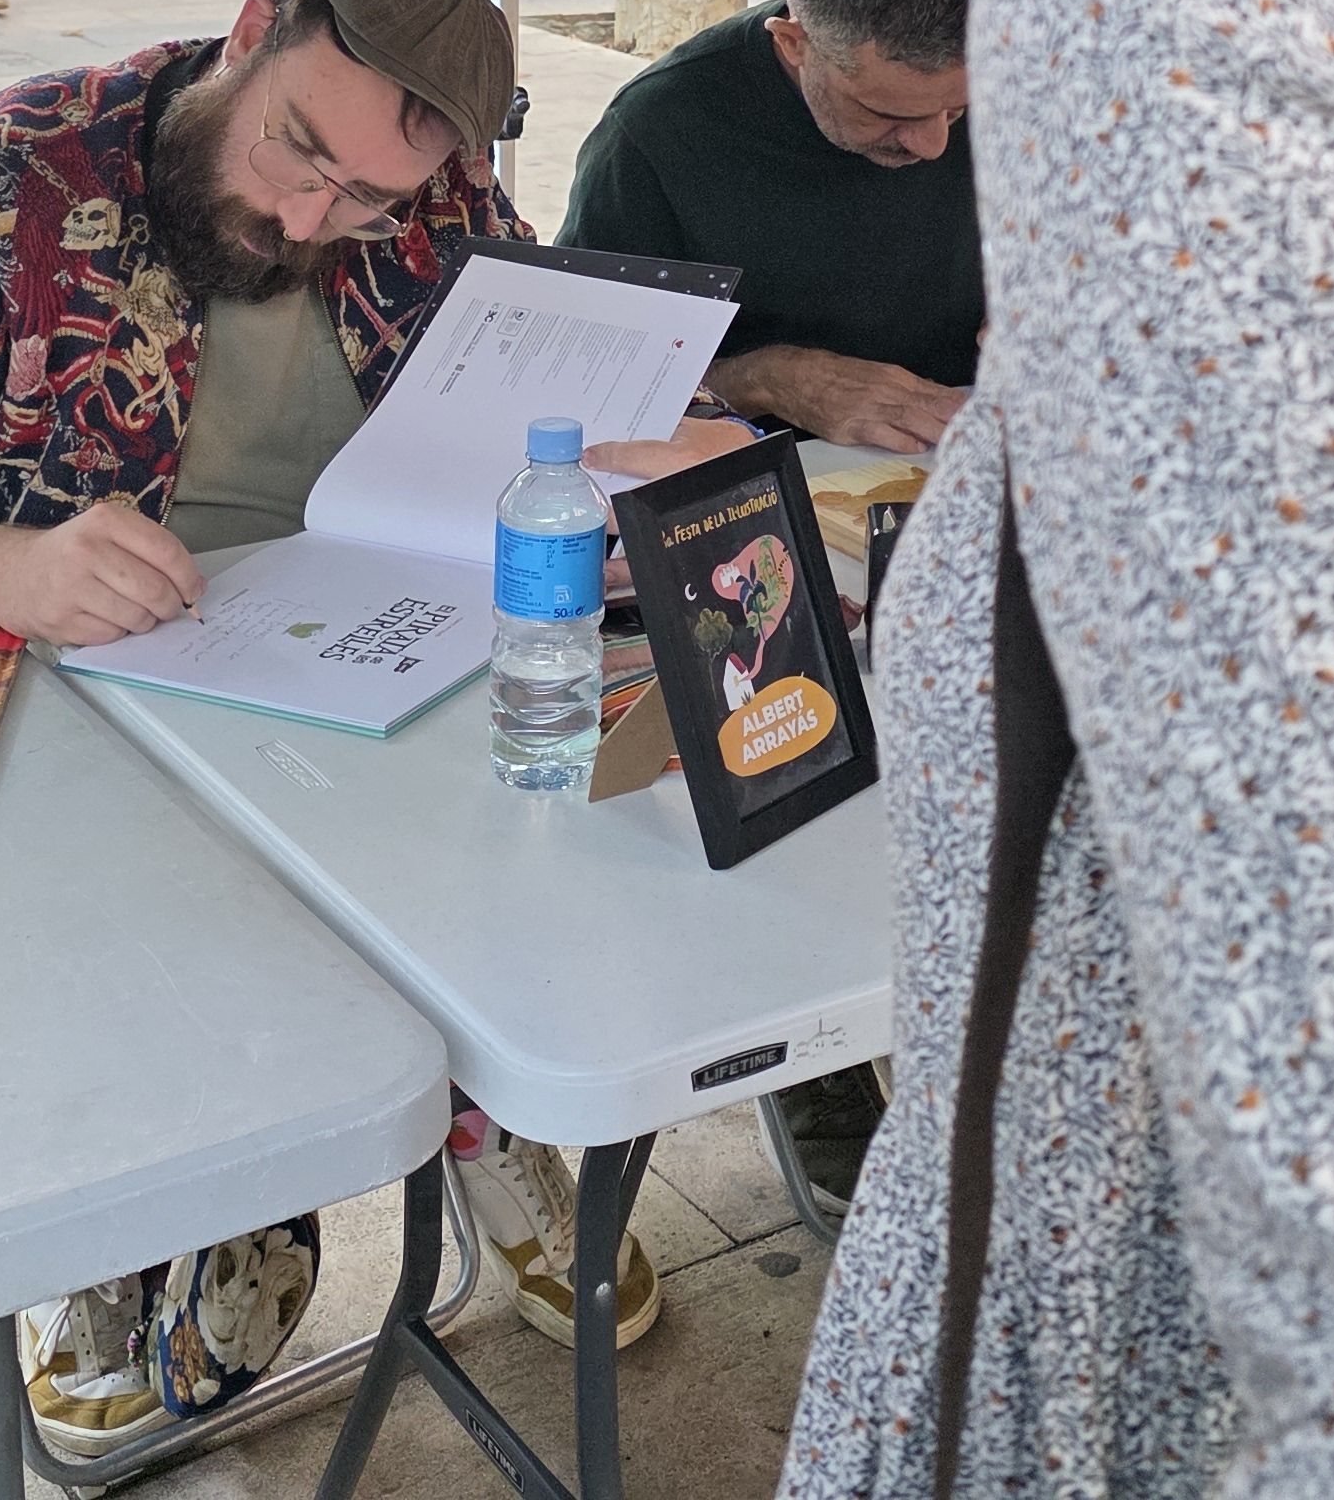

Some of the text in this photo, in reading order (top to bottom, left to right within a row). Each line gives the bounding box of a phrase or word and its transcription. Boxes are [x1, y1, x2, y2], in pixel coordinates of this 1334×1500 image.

[703, 516, 715, 533] DE
[319, 597, 430, 661] ESTRELLES
[365, 611, 451, 655] PIRATA
[743, 688, 804, 737] ALBERT
[743, 708, 819, 765] ARRAYÁS
[704, 1049, 778, 1084] LIFETIME
